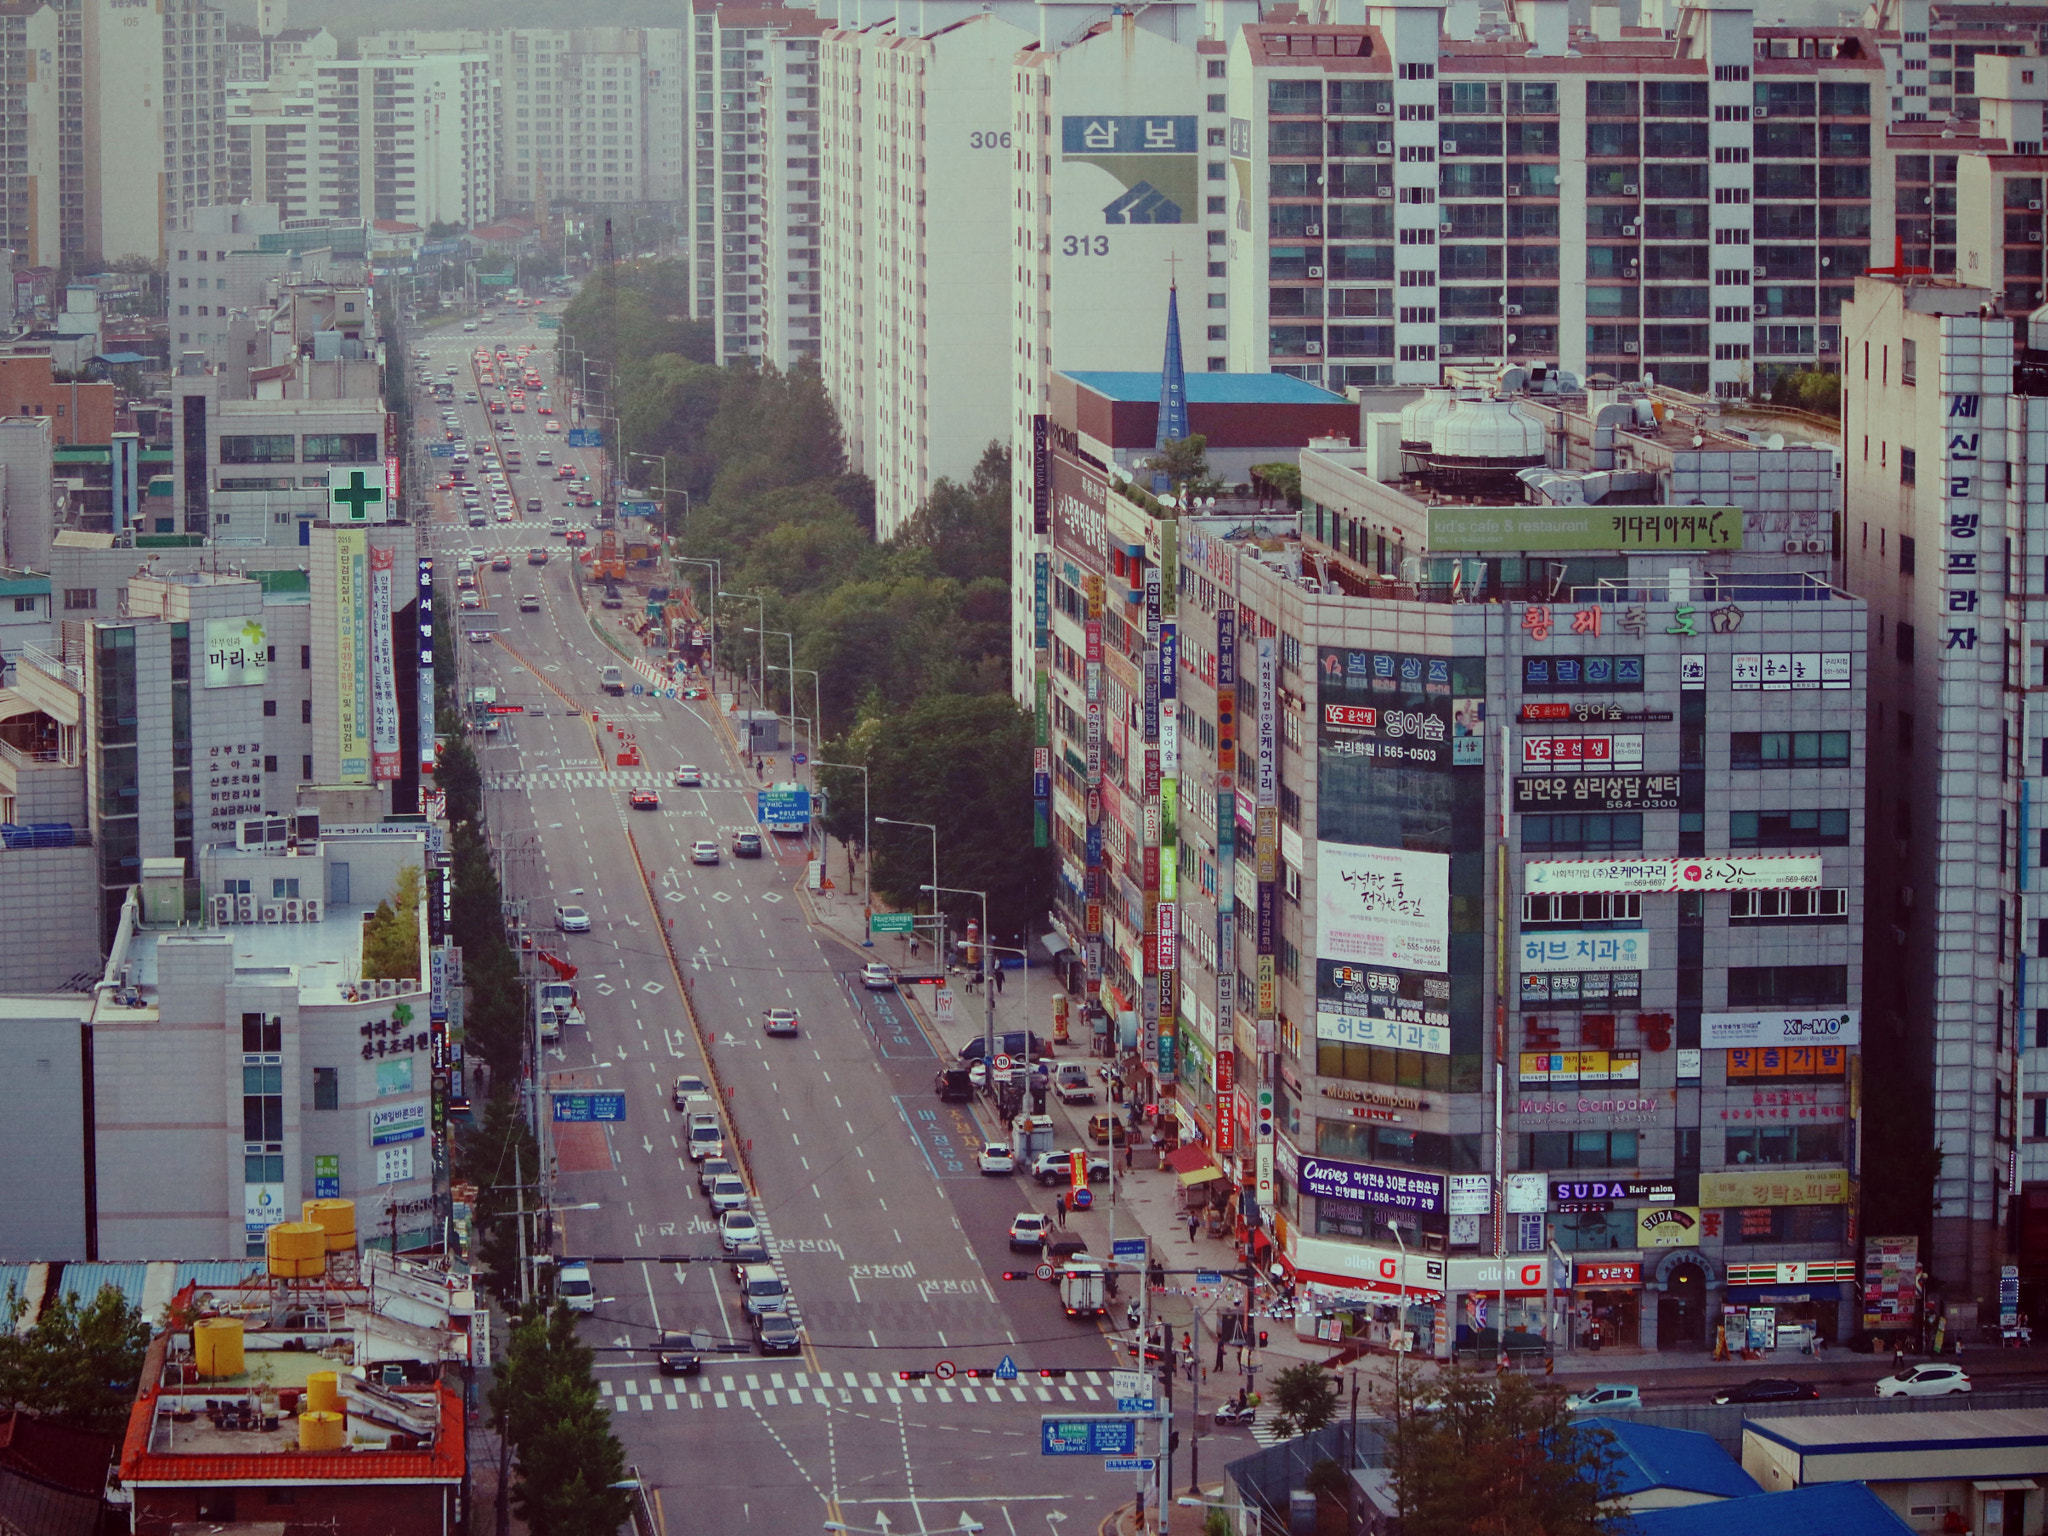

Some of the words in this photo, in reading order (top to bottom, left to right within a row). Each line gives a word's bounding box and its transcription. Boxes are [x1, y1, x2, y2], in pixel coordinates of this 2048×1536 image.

[123, 17, 139, 27] 105
[970, 131, 1011, 149] 306
[1083, 120, 1176, 149] 삼보
[1062, 235, 1109, 256] 313
[1036, 431, 1045, 487] SCALATIUM
[1434, 519, 1465, 533] kid's
[1471, 519, 1499, 533] cafe
[1504, 520, 1513, 532] &
[1518, 519, 1588, 533] restaurant
[420, 573, 433, 663] 윤서병원
[210, 637, 241, 648] 산부인과
[1220, 622, 1233, 682] 세무회계
[1347, 652, 1448, 682] 보람상조
[1526, 659, 1641, 681] 보람상조
[1735, 663, 1758, 678] 웅진
[1262, 661, 1272, 711] 사회적기업
[1347, 711, 1373, 724] 윤선생
[1544, 706, 1567, 716] 윤선생
[1574, 702, 1624, 722] 영어숲
[1384, 710, 1446, 742] 영어숲
[210, 743, 260, 757] 산부인과
[1164, 725, 1174, 761] 영어숲
[1334, 741, 1375, 757] 구리학원
[1384, 747, 1437, 763] 565-0503
[1526, 739, 1551, 761] YES
[1553, 742, 1604, 757] 윤선생
[210, 759, 260, 772] 소아과
[210, 774, 260, 787] 산후조리원
[1518, 778, 1566, 800] 김연우
[1573, 777, 1641, 800] 심리상담
[1646, 776, 1680, 798] 센터
[1606, 799, 1678, 809] 564-0300
[1260, 824, 1273, 874] 독서실
[1552, 868, 1590, 878] 사회적기업
[1407, 943, 1441, 953] 555-6696
[1525, 941, 1570, 964] 허브
[1576, 939, 1621, 962] 치과
[433, 966, 442, 1004] 제일바른
[1161, 971, 1171, 1006] SUDA
[1220, 978, 1232, 1000] 허브
[1366, 971, 1400, 994] 공부방
[1552, 975, 1580, 990] 공부방
[1220, 1005, 1232, 1029] 치과
[1337, 1016, 1375, 1040] 허브
[1386, 1023, 1425, 1048] 치과
[360, 1032, 429, 1060] 산후조리원
[1732, 1047, 1840, 1068] 맞춤가발
[1327, 1085, 1360, 1101] Music
[1362, 1090, 1420, 1110] Company
[1520, 1100, 1566, 1113] Music
[1577, 1098, 1658, 1113] Company
[380, 1103, 424, 1123] 제일바른의원
[1263, 1157, 1271, 1178] olleh
[1304, 1161, 1349, 1186] Curves
[1353, 1171, 1385, 1191] 여성전용
[1386, 1175, 1407, 1193] 30분
[1407, 1179, 1440, 1196] 순환운동
[1451, 1177, 1488, 1189] 커브스
[1557, 1183, 1626, 1200] SUDA
[1629, 1185, 1648, 1193] Hair
[1650, 1185, 1673, 1193] salon
[1310, 1182, 1333, 1195] 커브스
[1335, 1185, 1365, 1200] 인창클럽
[1367, 1190, 1416, 1207] T.558-3077
[1643, 1210, 1673, 1230] SUDA
[1528, 1222, 1541, 1250] MINUTES
[1038, 1268, 1051, 1277] 60
[1344, 1257, 1376, 1271] olleh
[1599, 1267, 1634, 1279] 정관장
